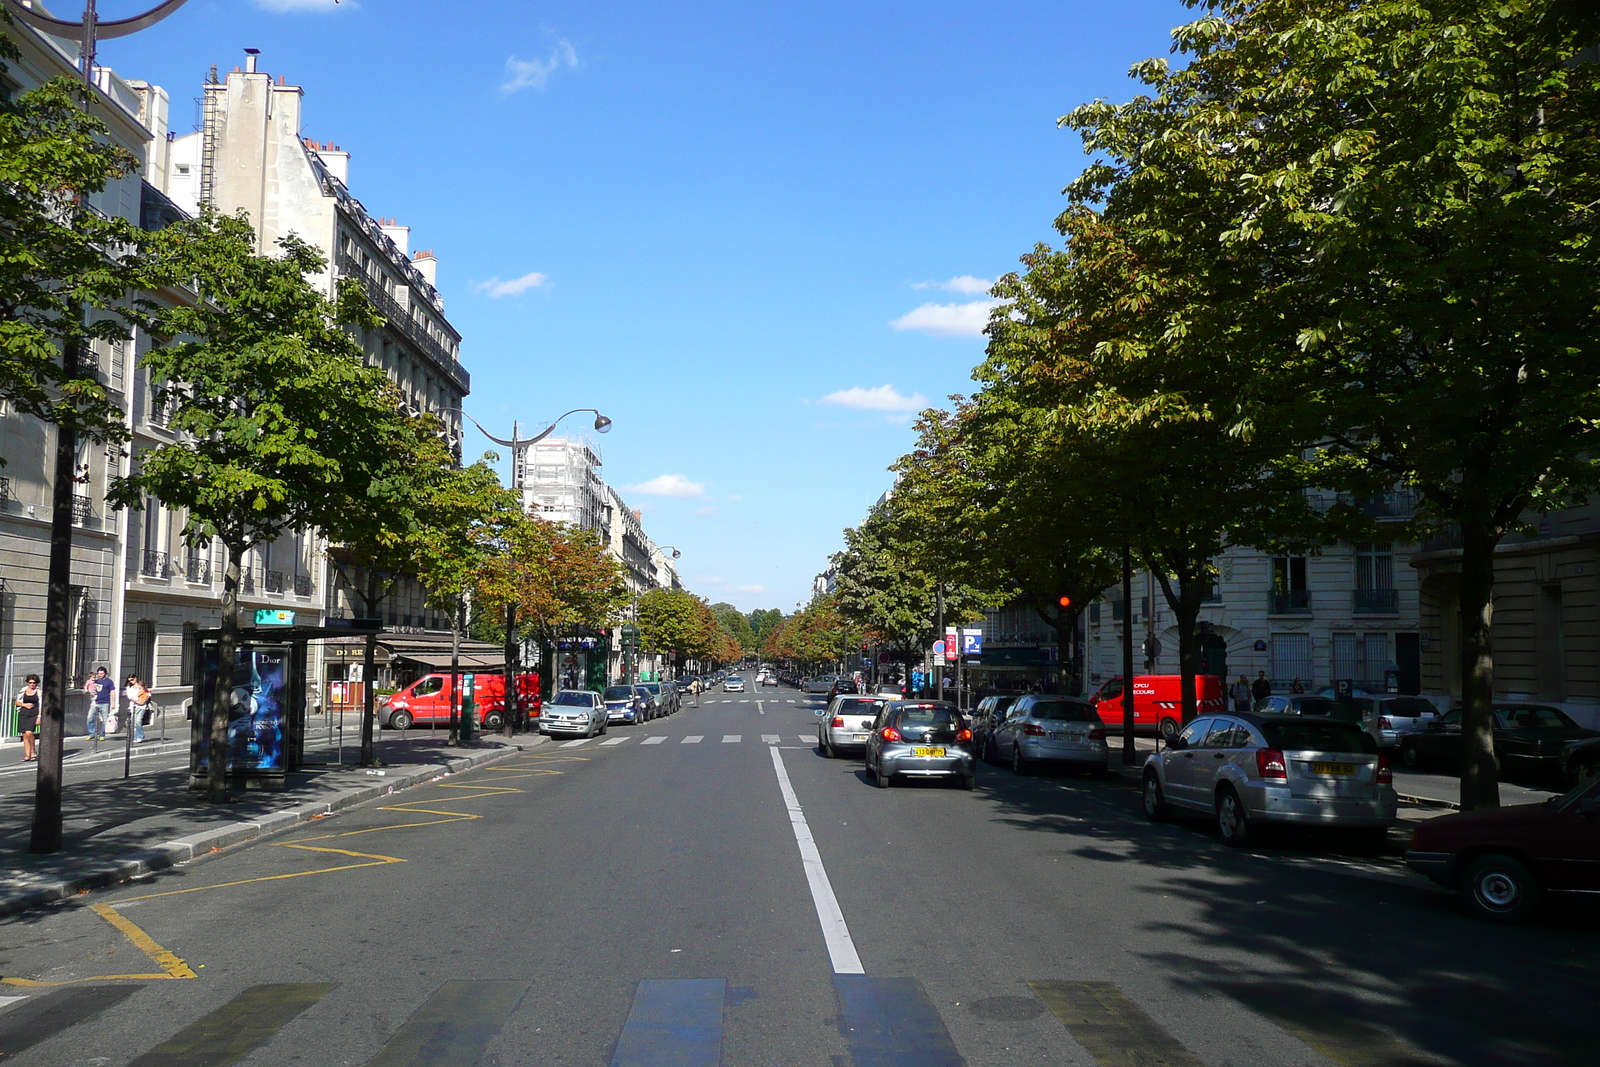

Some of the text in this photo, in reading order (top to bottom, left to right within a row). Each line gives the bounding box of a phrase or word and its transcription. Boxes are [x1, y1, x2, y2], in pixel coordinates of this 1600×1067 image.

[965, 636, 976, 648] P
[261, 654, 280, 664] Dior
[1339, 681, 1348, 693] P
[1313, 763, 1323, 771] 711
